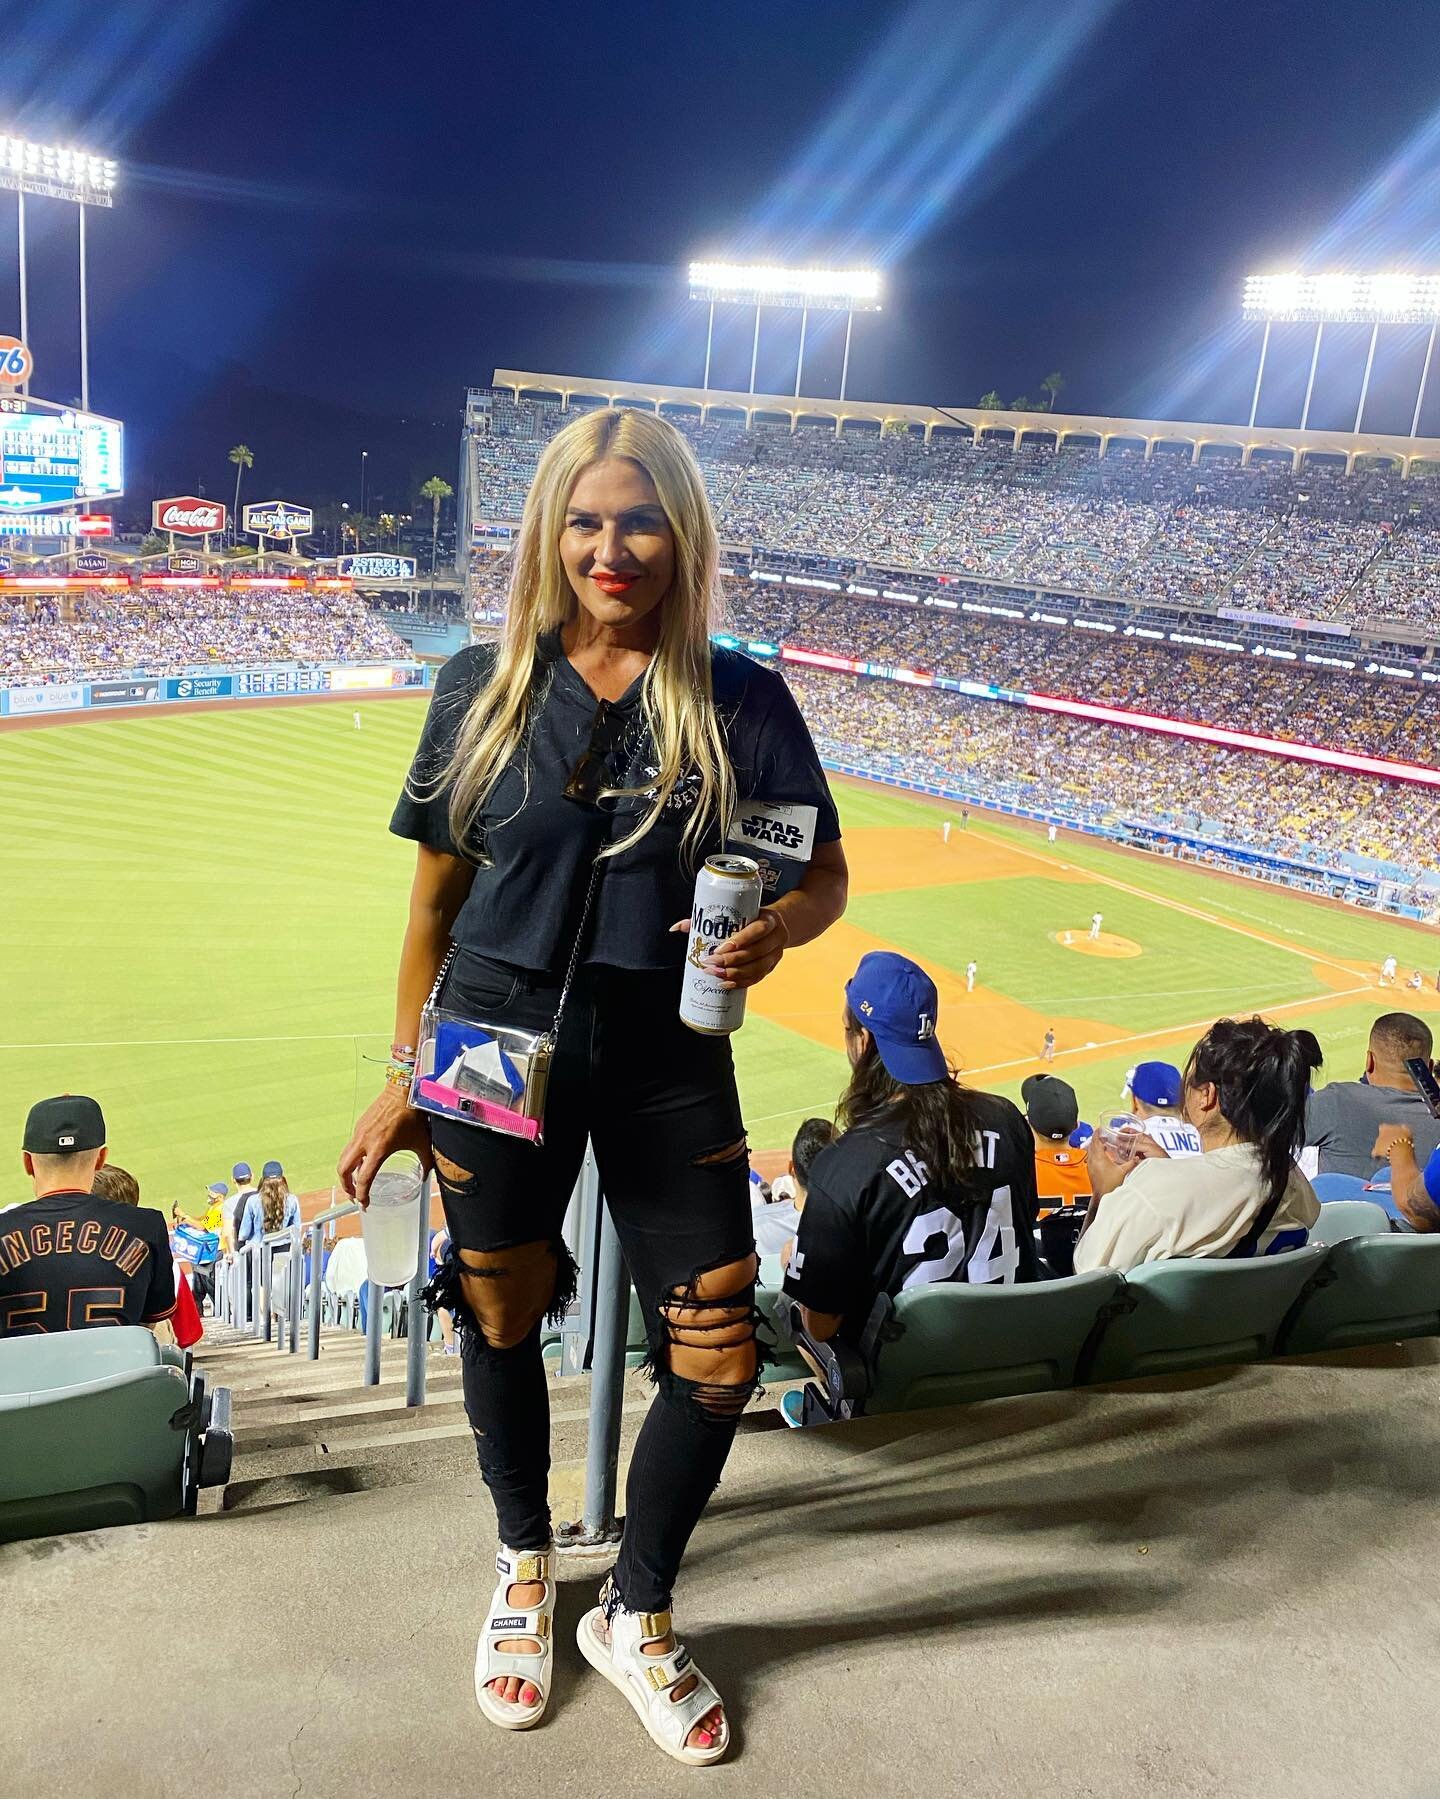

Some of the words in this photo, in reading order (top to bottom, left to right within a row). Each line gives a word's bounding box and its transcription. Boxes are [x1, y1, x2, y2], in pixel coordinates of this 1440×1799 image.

[163, 506, 220, 527] Coca-Cola
[286, 515, 310, 525] GAME
[347, 566, 397, 577] JALISCO
[194, 679, 222, 688] Security
[194, 687, 218, 696] Benefit
[741, 823, 804, 849] WARS
[742, 815, 804, 840] STAR
[860, 1000, 873, 1017] 24
[918, 1013, 934, 1040] LA
[902, 1184, 1020, 1290] 24
[493, 1618, 523, 1628] CHANEL
